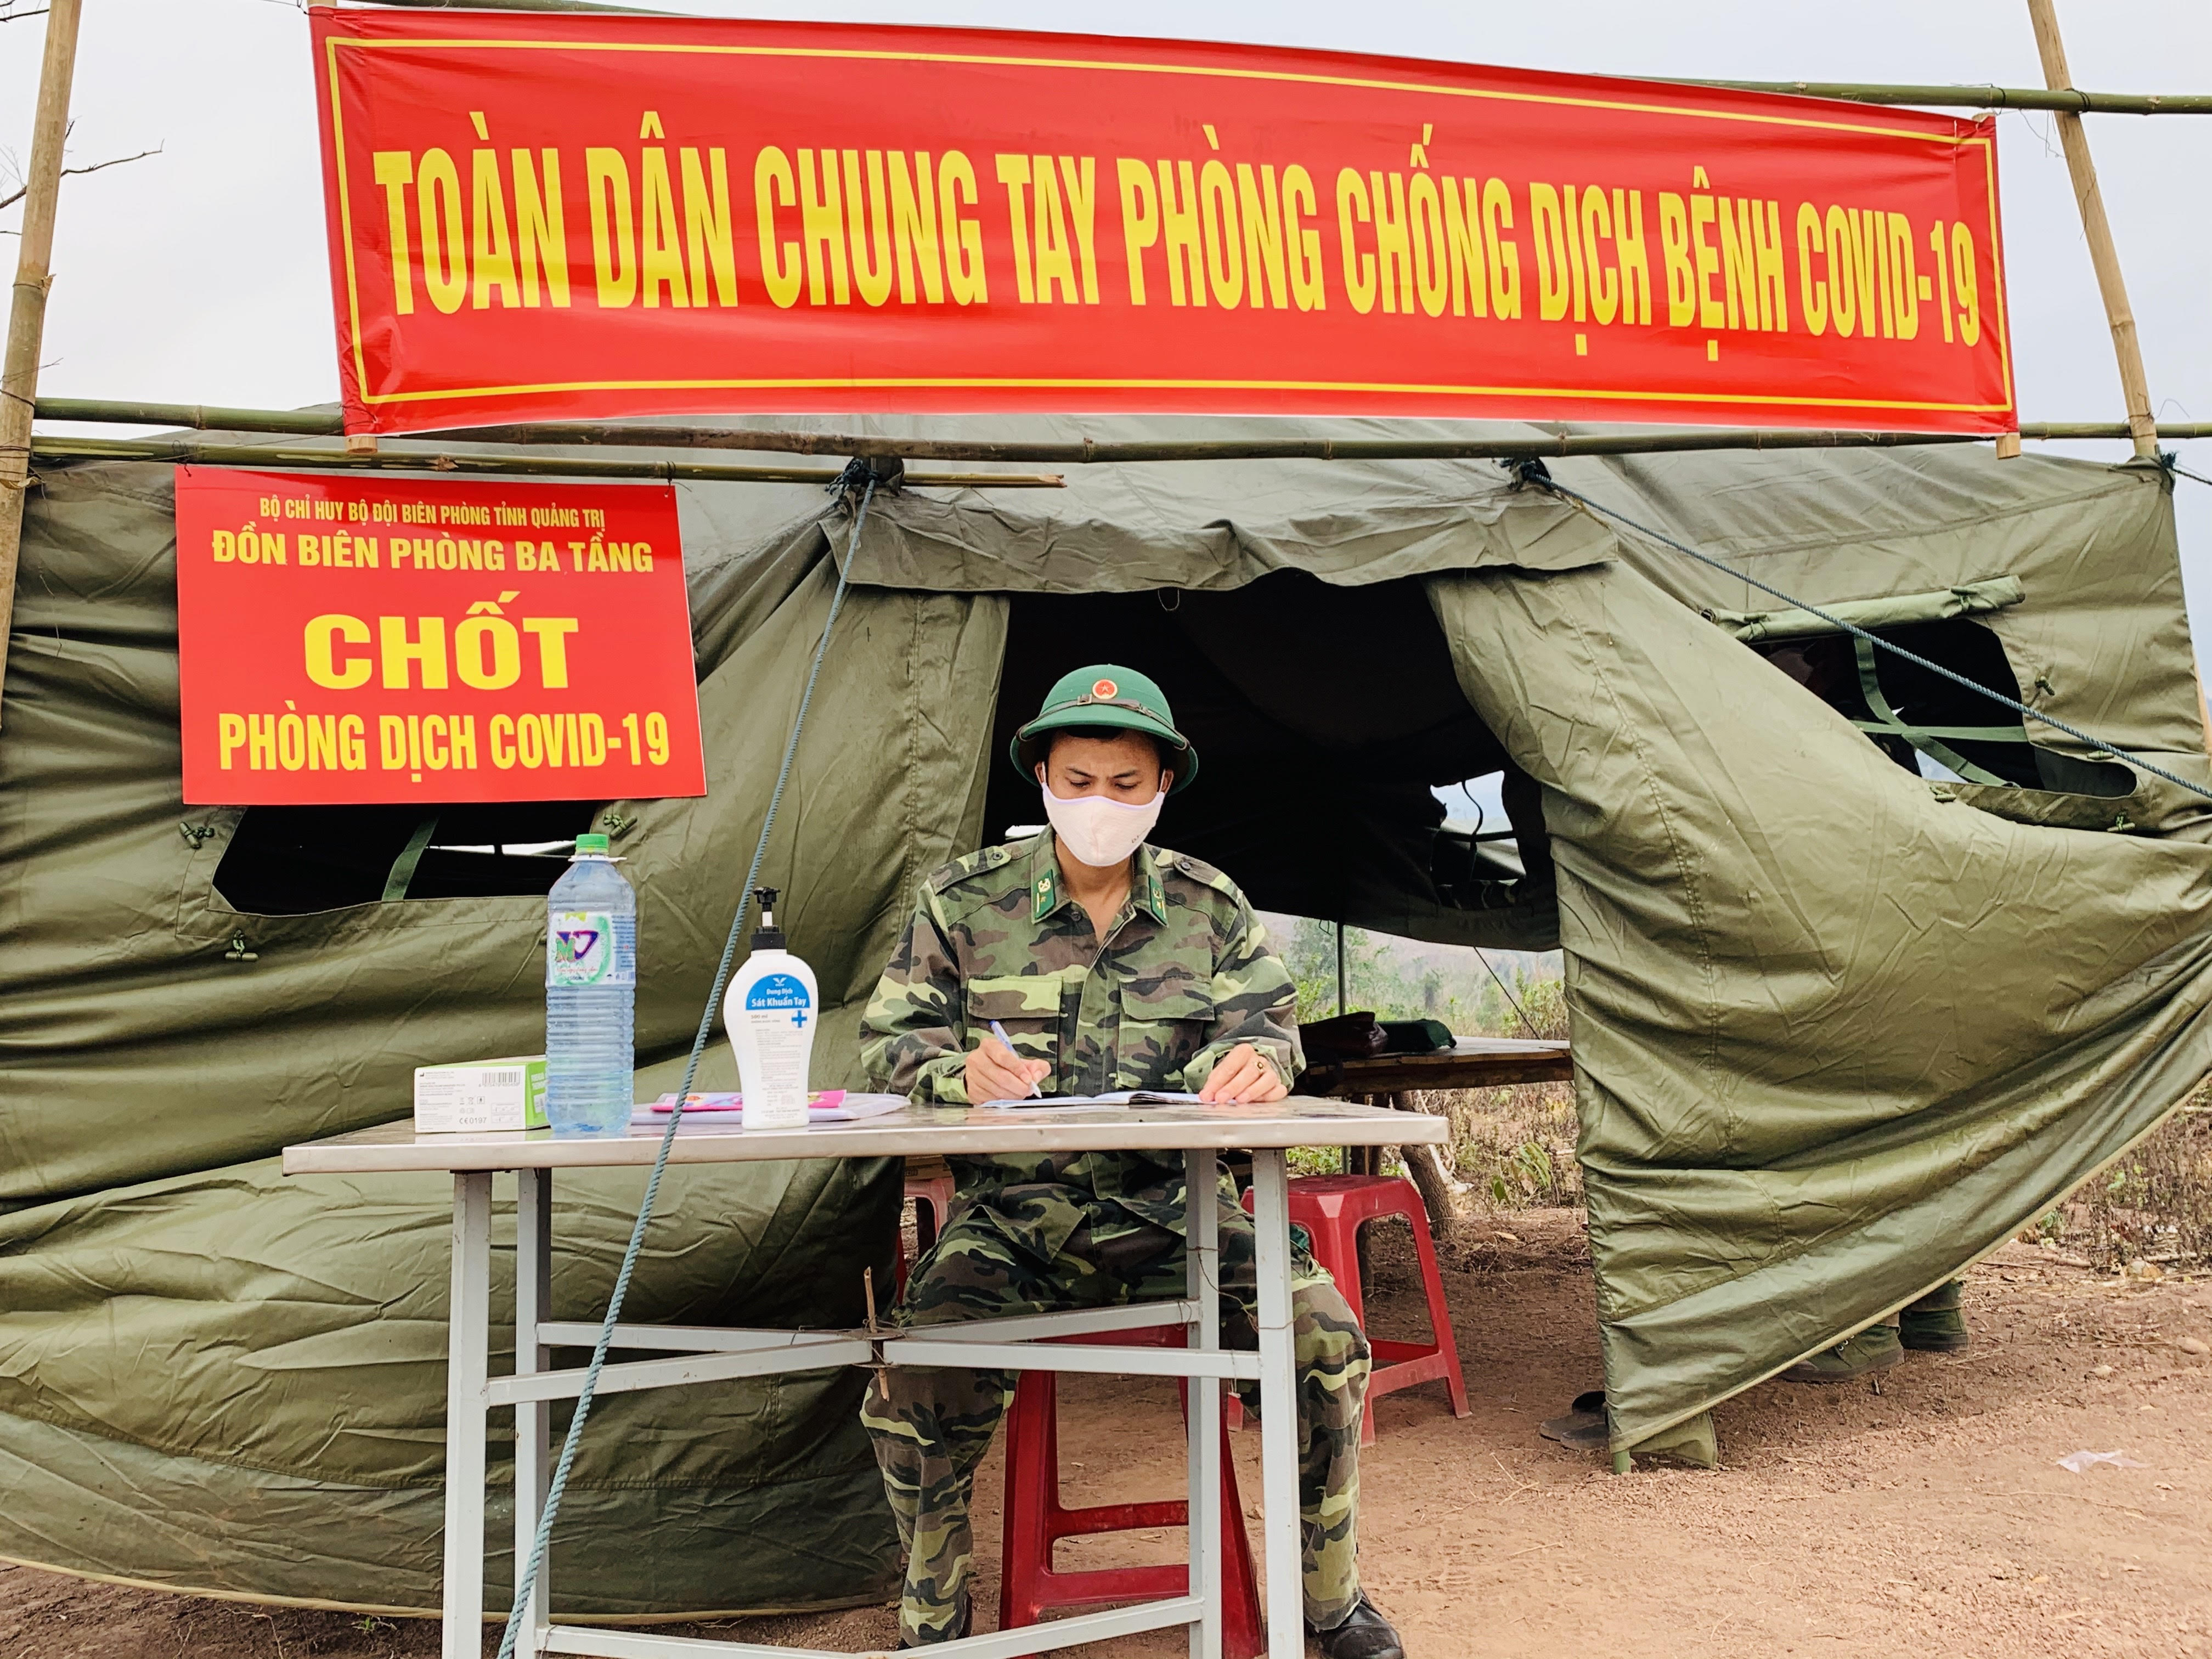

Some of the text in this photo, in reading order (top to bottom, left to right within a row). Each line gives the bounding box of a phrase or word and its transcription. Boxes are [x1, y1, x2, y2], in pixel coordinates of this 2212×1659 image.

[373, 111, 1980, 362] TOÀN DÂN CHUNG TAY PHÒNG CHỐNG DỊCH BỆNH COVID-19
[259, 494, 606, 532] BỘ CHỈ HUY BỘ ĐỘI BIÊN PHÒNG TỈNH QUẢNG TRỊ
[212, 521, 654, 572] ĐỒN BIÊN PHÒNG BA TẦNG
[304, 591, 579, 690] CHỐT
[219, 700, 670, 782] PHÒNG DỊCH COVID-19
[752, 996, 806, 1008] Sát Khuẩn Tay
[781, 988, 793, 996] Dịch
